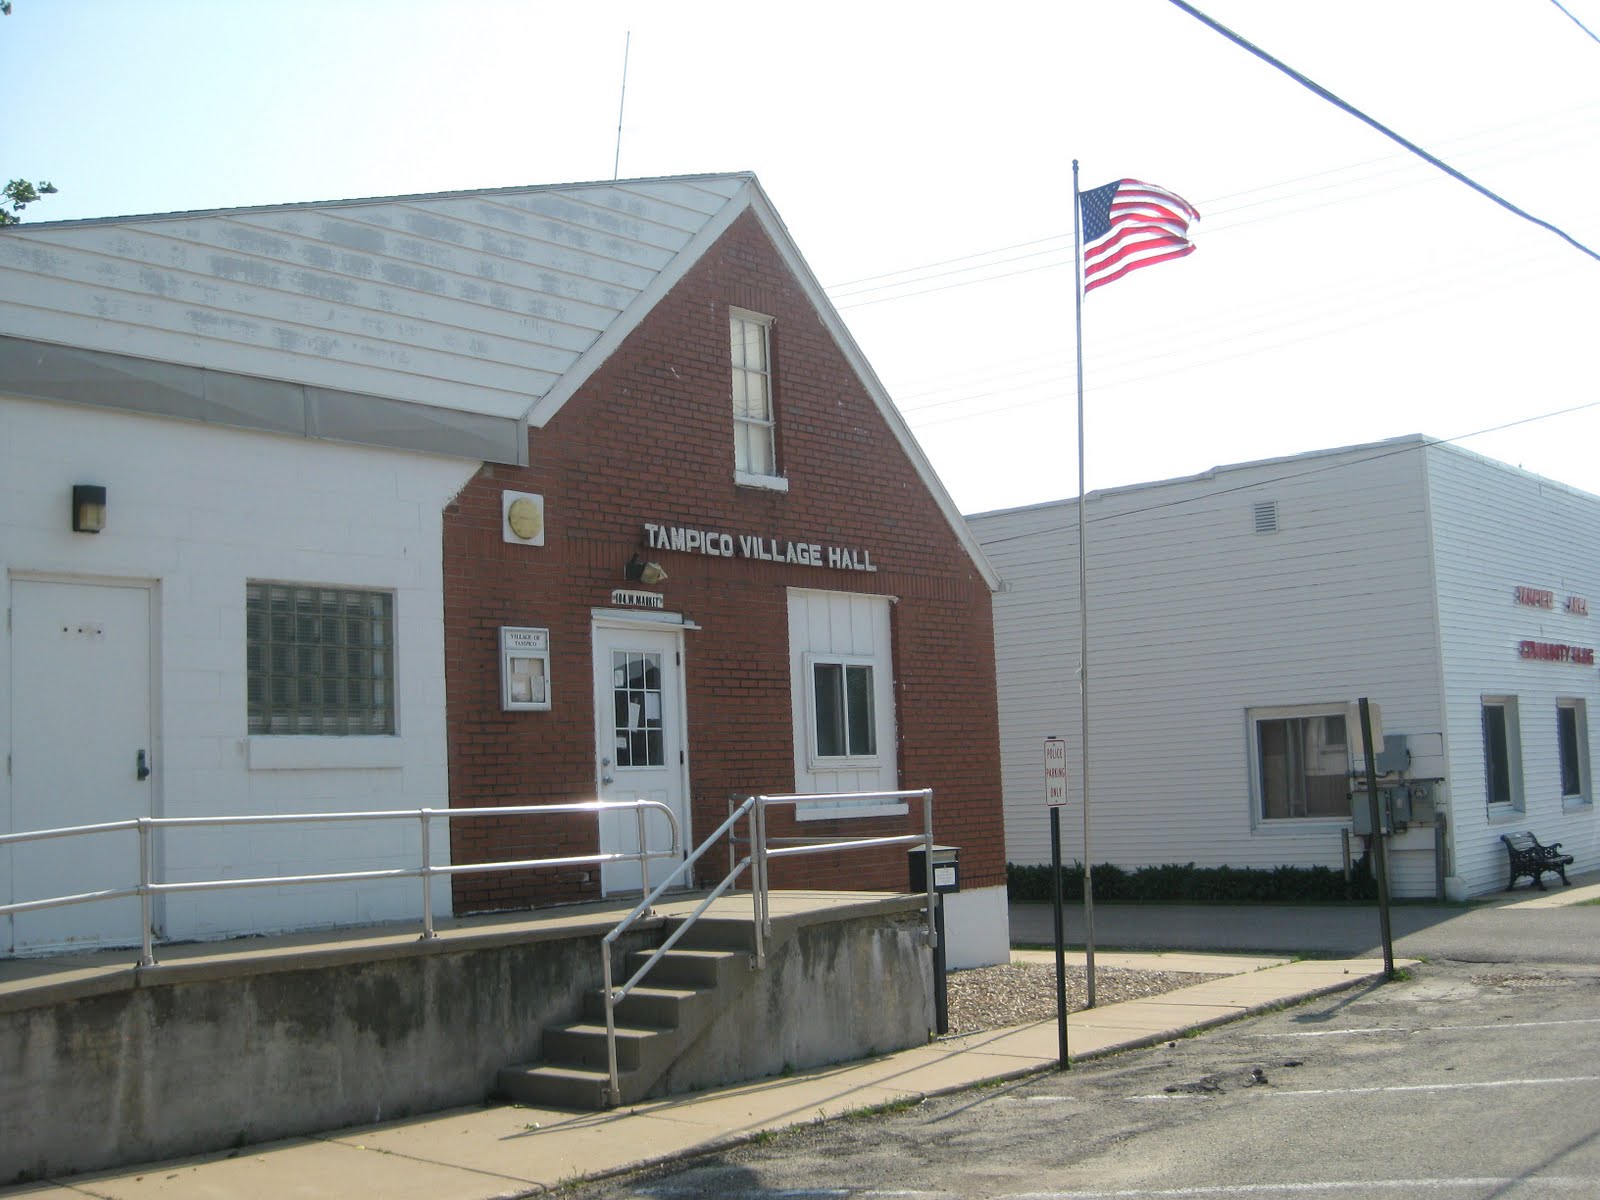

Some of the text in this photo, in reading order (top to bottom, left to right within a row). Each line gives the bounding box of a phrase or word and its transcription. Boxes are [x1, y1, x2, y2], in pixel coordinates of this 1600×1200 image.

[644, 523, 878, 572] TAMPICO VILLAGE HALL
[636, 595, 659, 608] MARKET
[1047, 748, 1063, 759] POLICE
[1046, 767, 1065, 778] PARKING
[1050, 787, 1062, 798] ONLY
